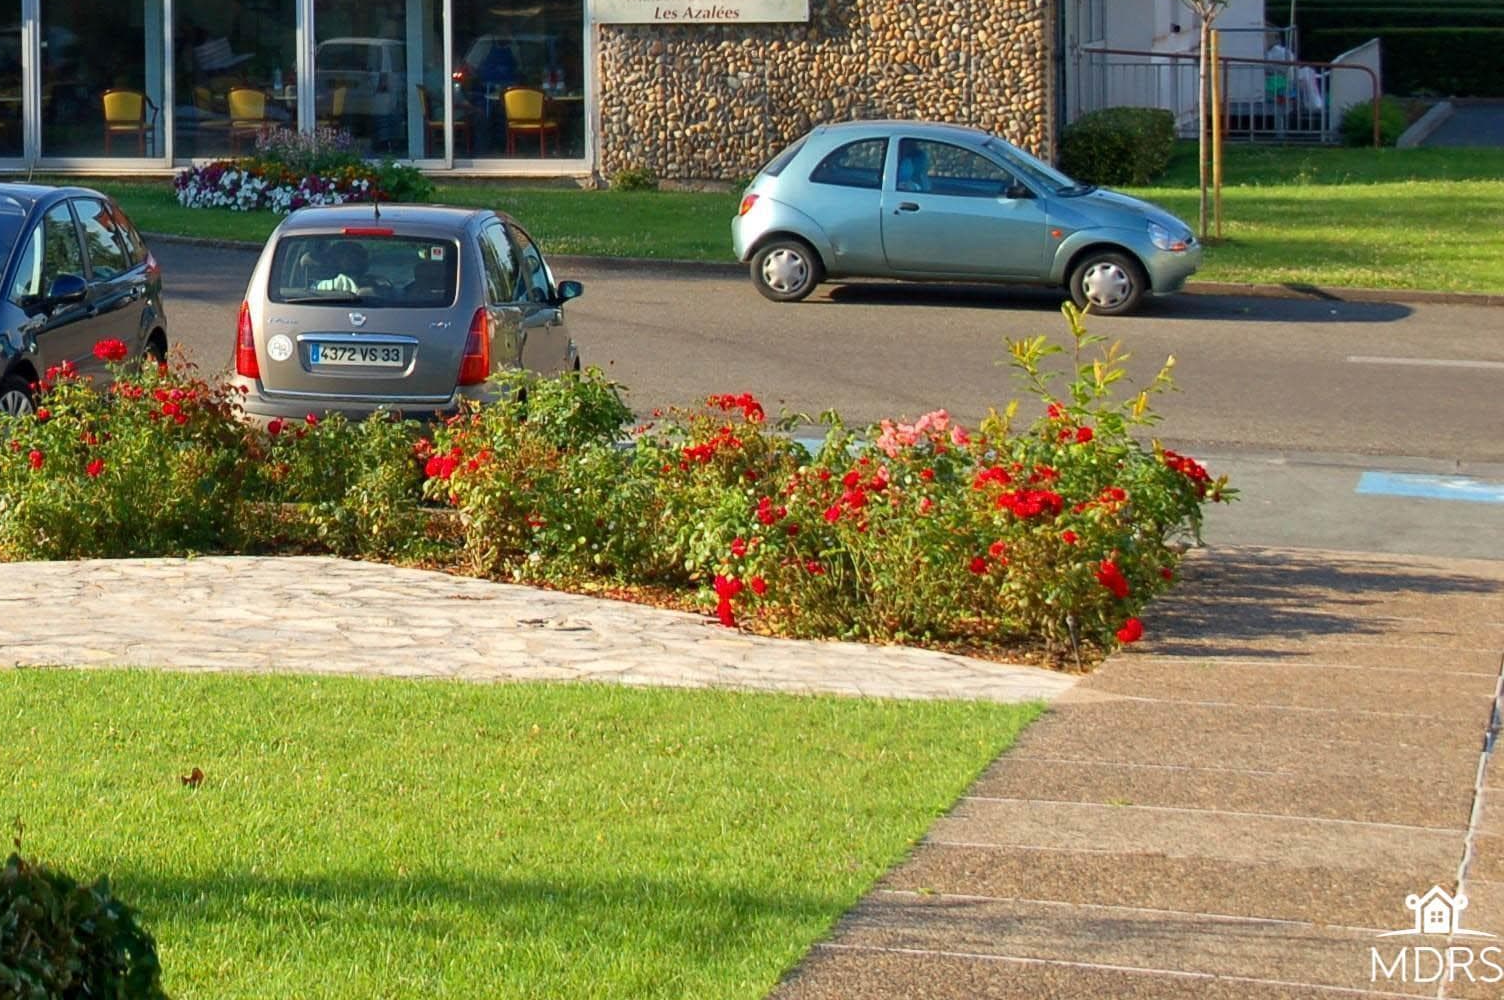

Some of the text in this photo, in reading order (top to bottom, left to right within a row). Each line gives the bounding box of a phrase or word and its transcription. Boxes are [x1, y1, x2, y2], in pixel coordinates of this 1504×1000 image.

[654, 5, 740, 20] Les Azalées
[320, 348, 400, 362] 4372 VS 33
